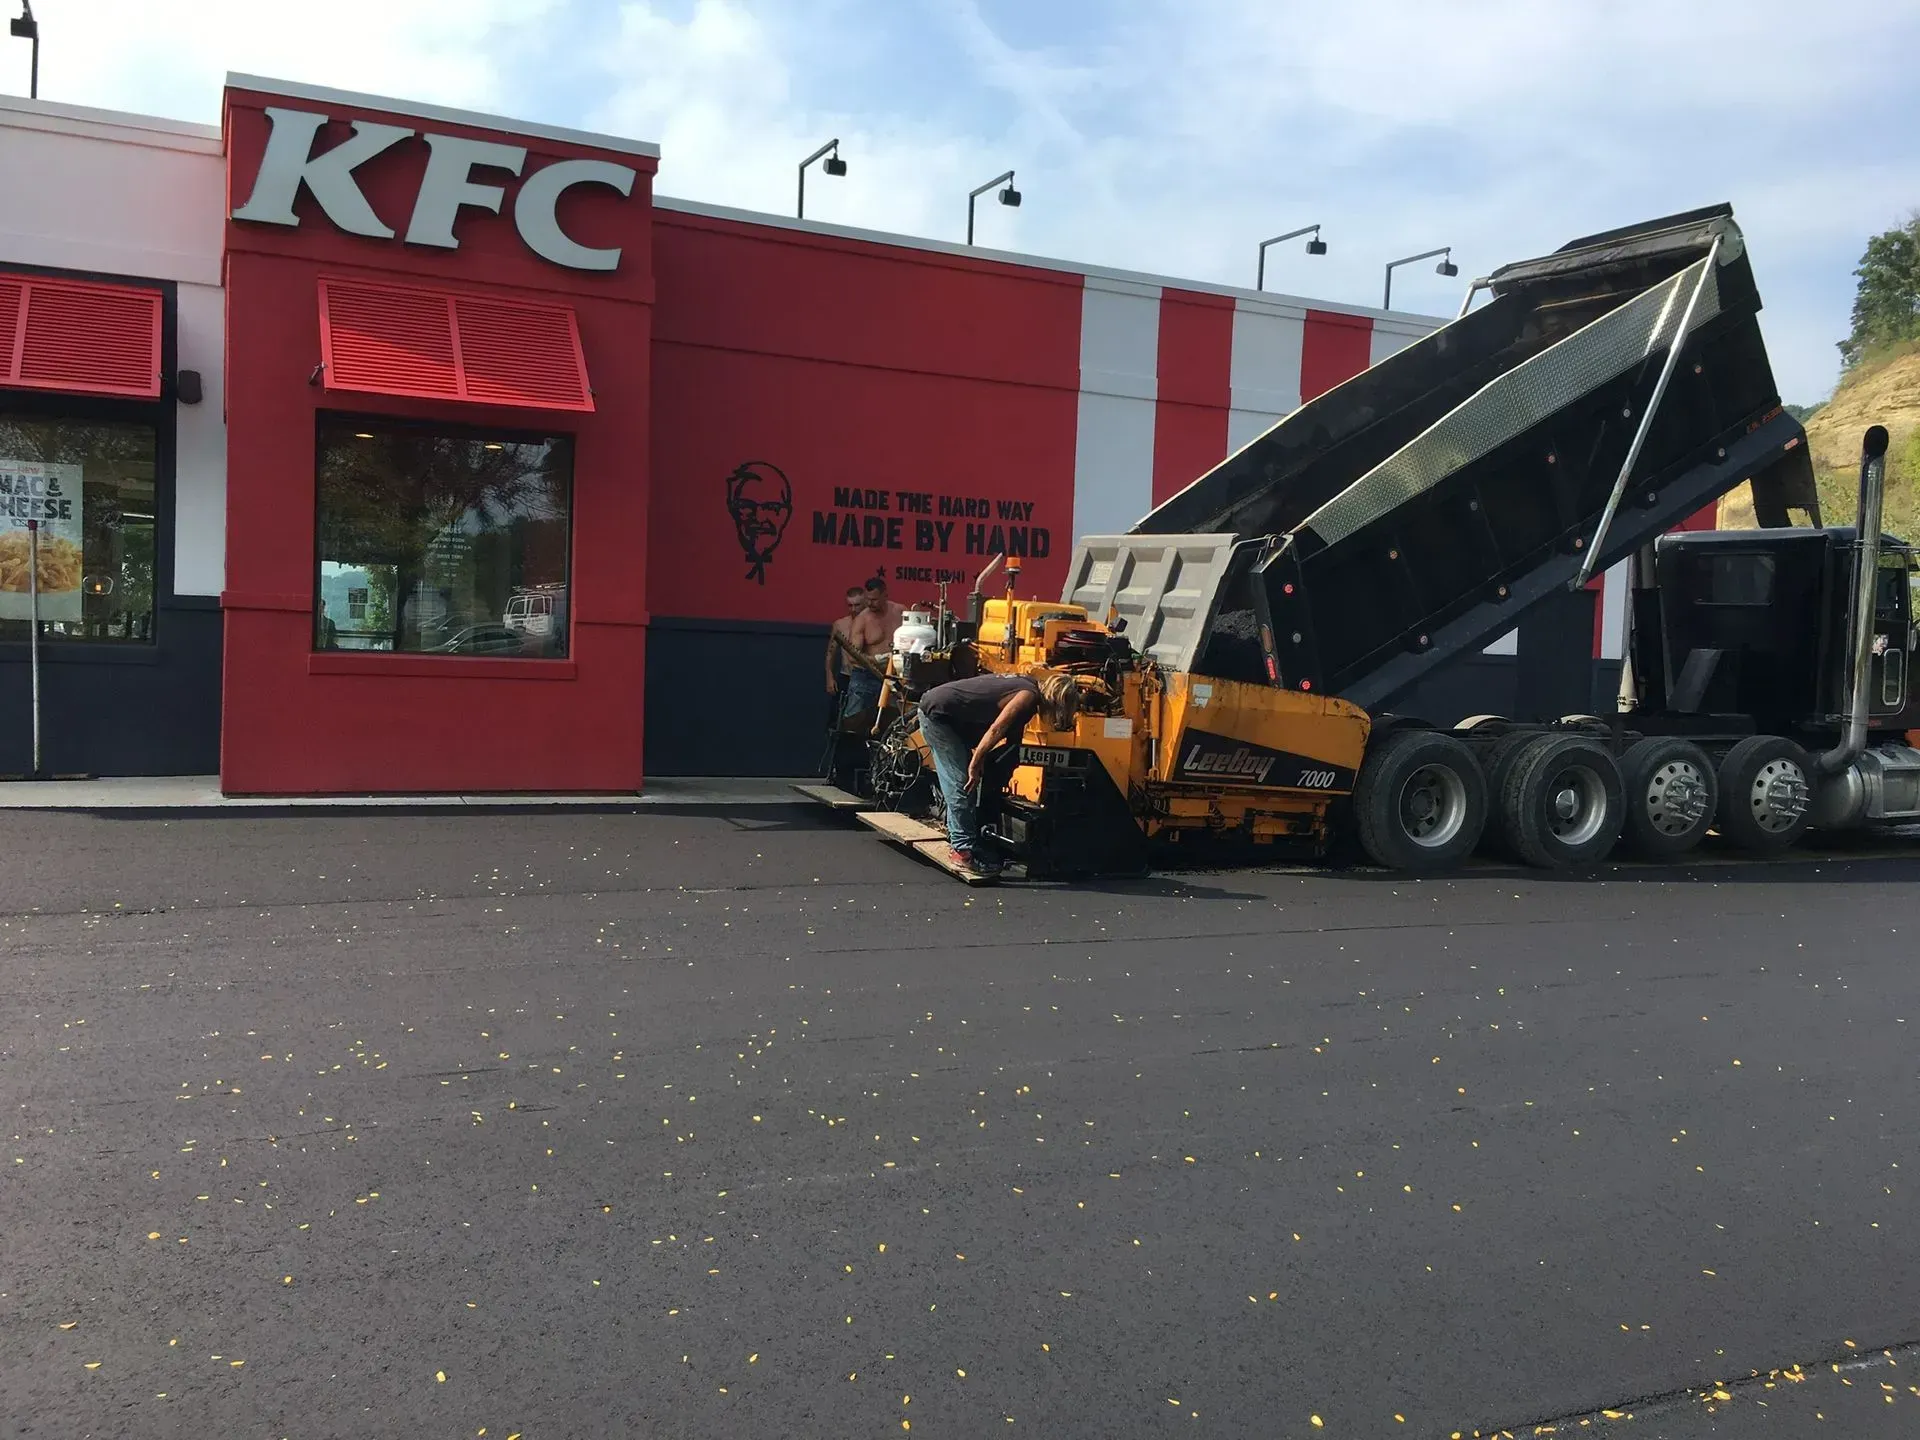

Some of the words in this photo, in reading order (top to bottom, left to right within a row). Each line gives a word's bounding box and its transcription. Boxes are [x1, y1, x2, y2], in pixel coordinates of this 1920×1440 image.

[231, 106, 636, 271] KFC
[0, 474, 44, 497] MAC
[0, 496, 72, 520] HEESE
[834, 487, 889, 510] MADE
[896, 492, 932, 514] THE
[939, 496, 990, 518] HARD
[997, 500, 1034, 522] WAY
[812, 511, 904, 550] MADE
[916, 519, 954, 552] BY
[966, 523, 1051, 558] HAND
[895, 566, 932, 582] SINCE
[1183, 744, 1276, 783] LeeBoy
[1297, 769, 1336, 788] 7000
